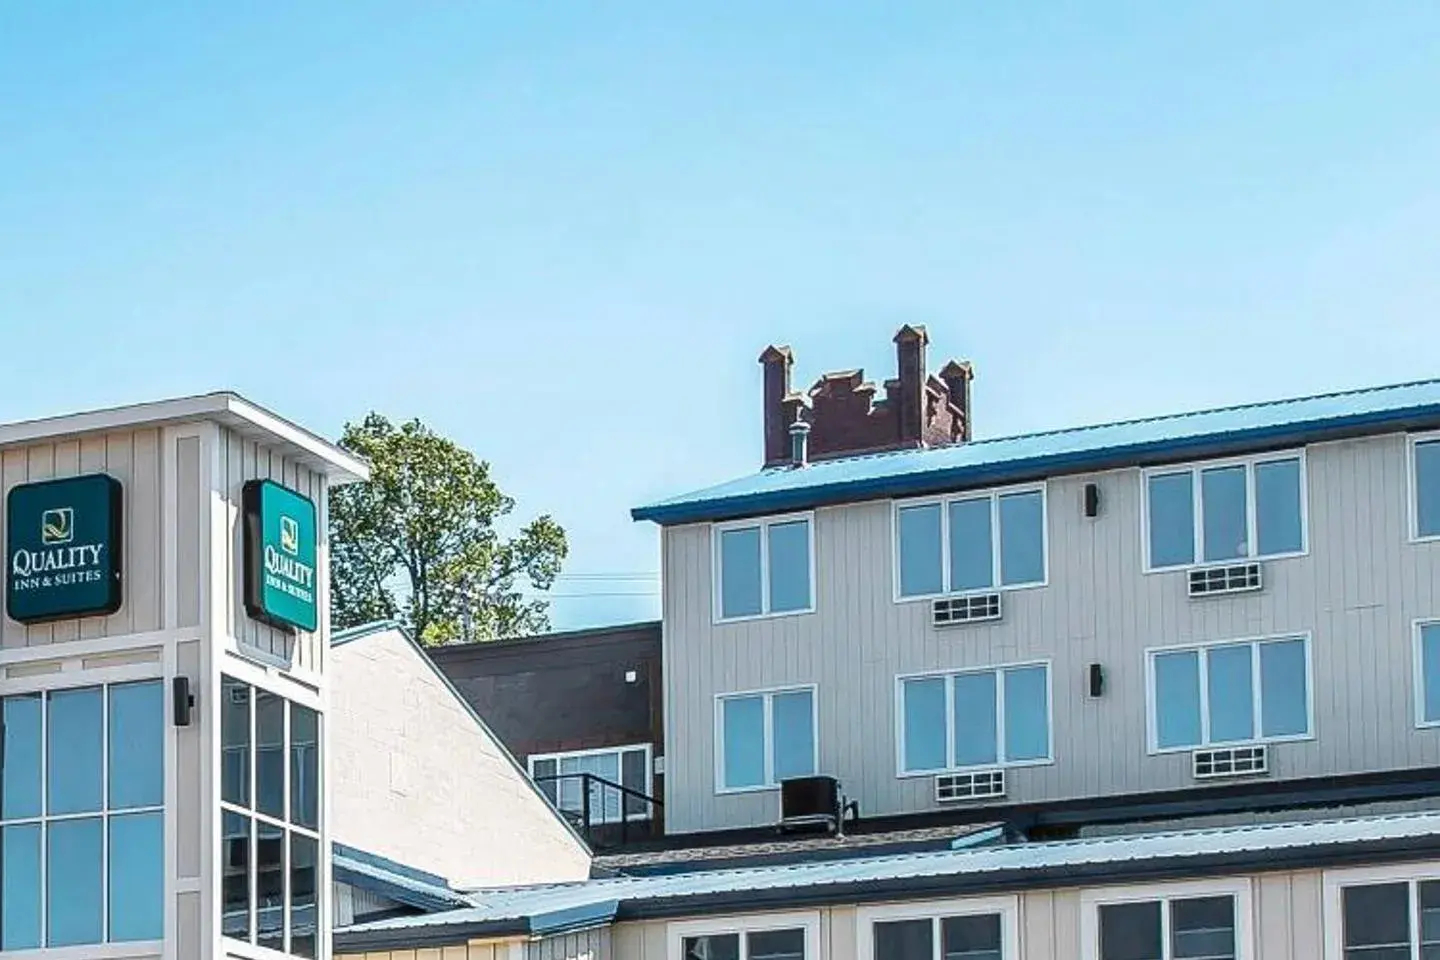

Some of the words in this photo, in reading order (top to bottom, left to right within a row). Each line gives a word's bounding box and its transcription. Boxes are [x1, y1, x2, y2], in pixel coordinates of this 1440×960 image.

[13, 543, 103, 577] QUALITY
[264, 544, 314, 588] QUALITY
[14, 577, 40, 591] INN
[42, 575, 53, 587] &
[54, 569, 102, 587] SUITES
[266, 573, 281, 589] INN
